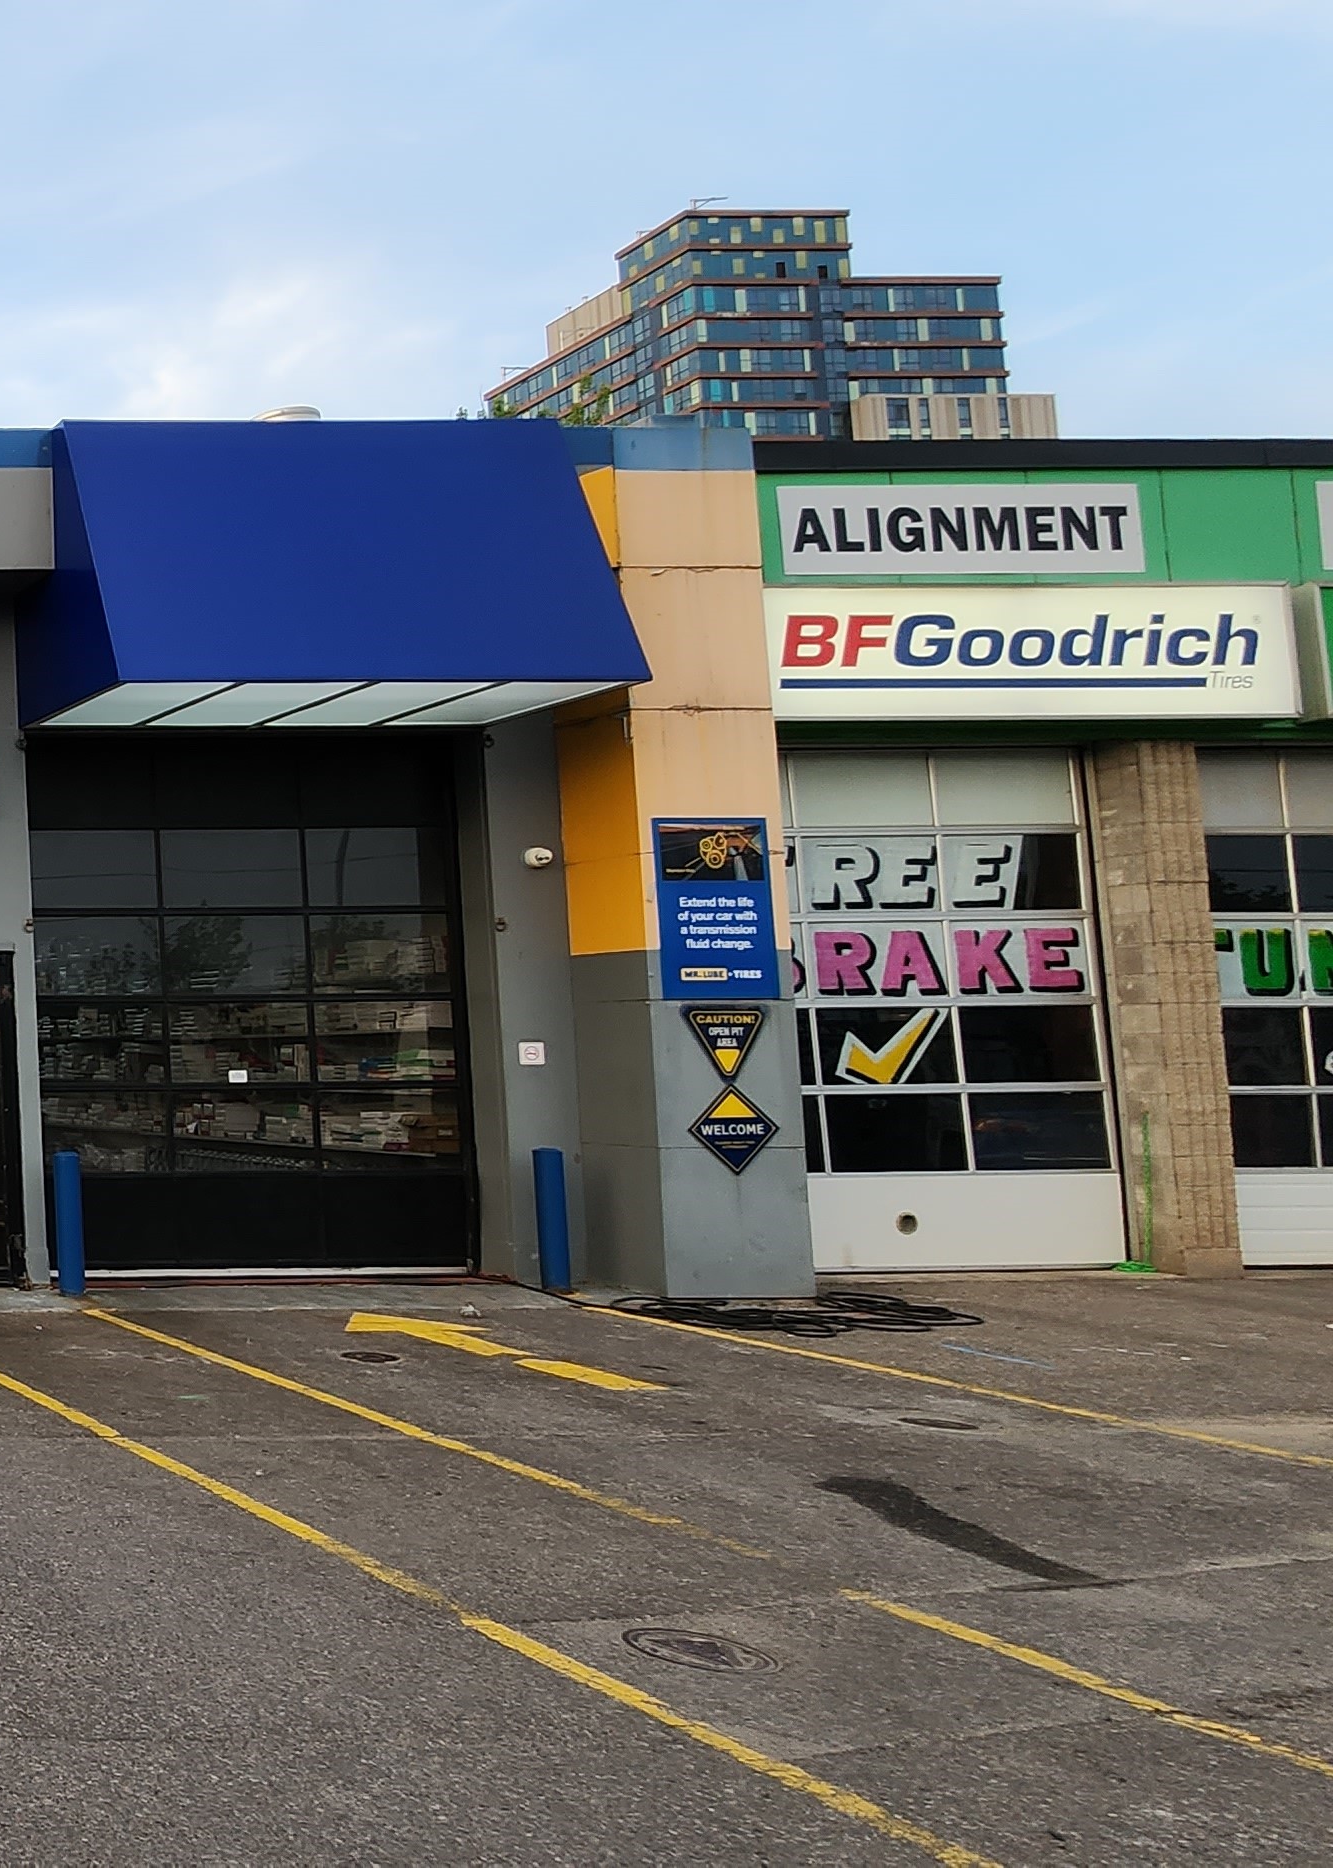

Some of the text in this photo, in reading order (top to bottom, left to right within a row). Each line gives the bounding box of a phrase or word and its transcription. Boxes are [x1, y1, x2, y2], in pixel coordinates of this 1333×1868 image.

[793, 505, 1129, 554] ALIGNMENT
[780, 613, 1260, 668] BFGoodrich
[1209, 670, 1254, 691] Tires
[784, 843, 1013, 910] REE
[679, 897, 754, 907] Extend the life
[677, 911, 758, 923] of your car with
[680, 924, 758, 934] a transmission
[686, 938, 754, 950] fluid change.
[791, 927, 1085, 996] RAKE
[696, 1015, 755, 1024] CAUTION!
[708, 1027, 744, 1036] OPEN PIT
[716, 1038, 738, 1046] AREA
[700, 1124, 765, 1135] WELCOME
